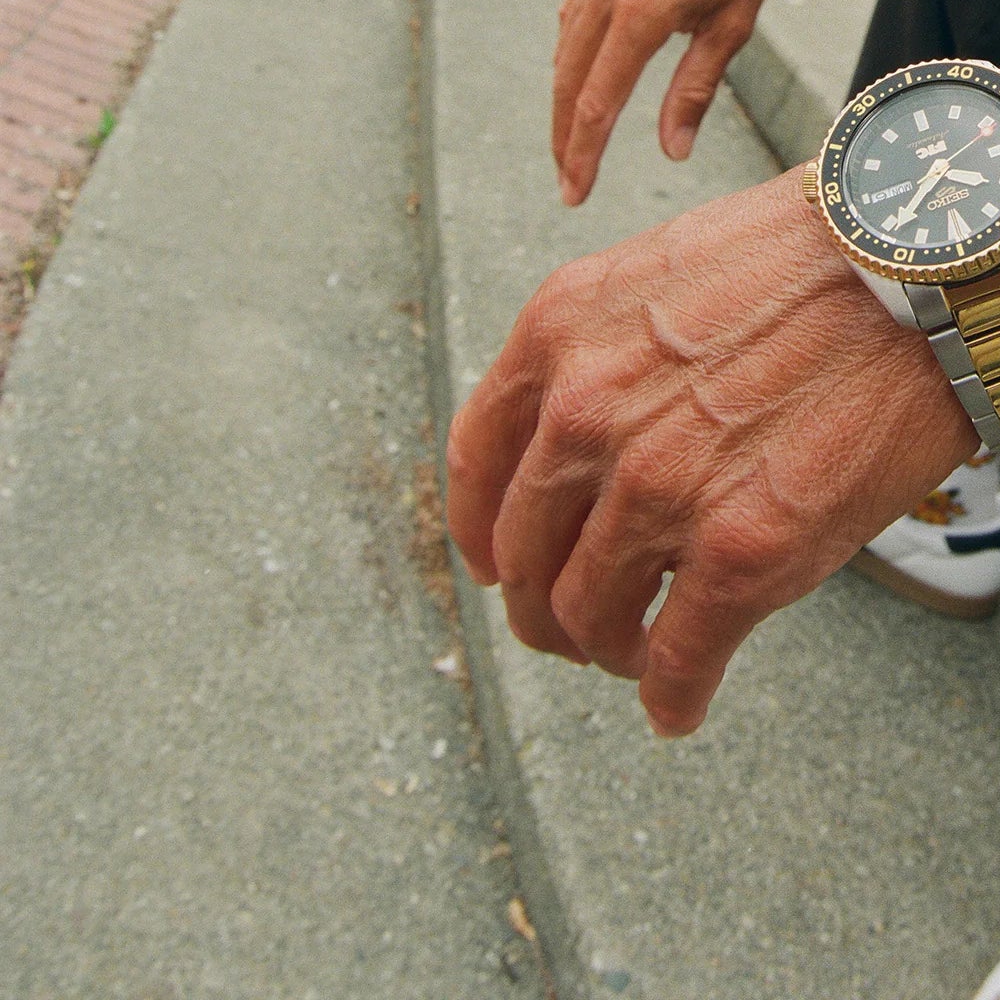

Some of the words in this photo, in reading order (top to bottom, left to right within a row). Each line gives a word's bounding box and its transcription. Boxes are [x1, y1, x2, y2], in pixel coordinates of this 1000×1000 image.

[946, 66, 974, 79] 40
[852, 95, 876, 116] 30
[915, 140, 947, 160] FTC
[826, 182, 840, 206] 20
[890, 181, 913, 198] MON
[927, 188, 970, 211] SEIKO
[893, 249, 915, 263] 10
